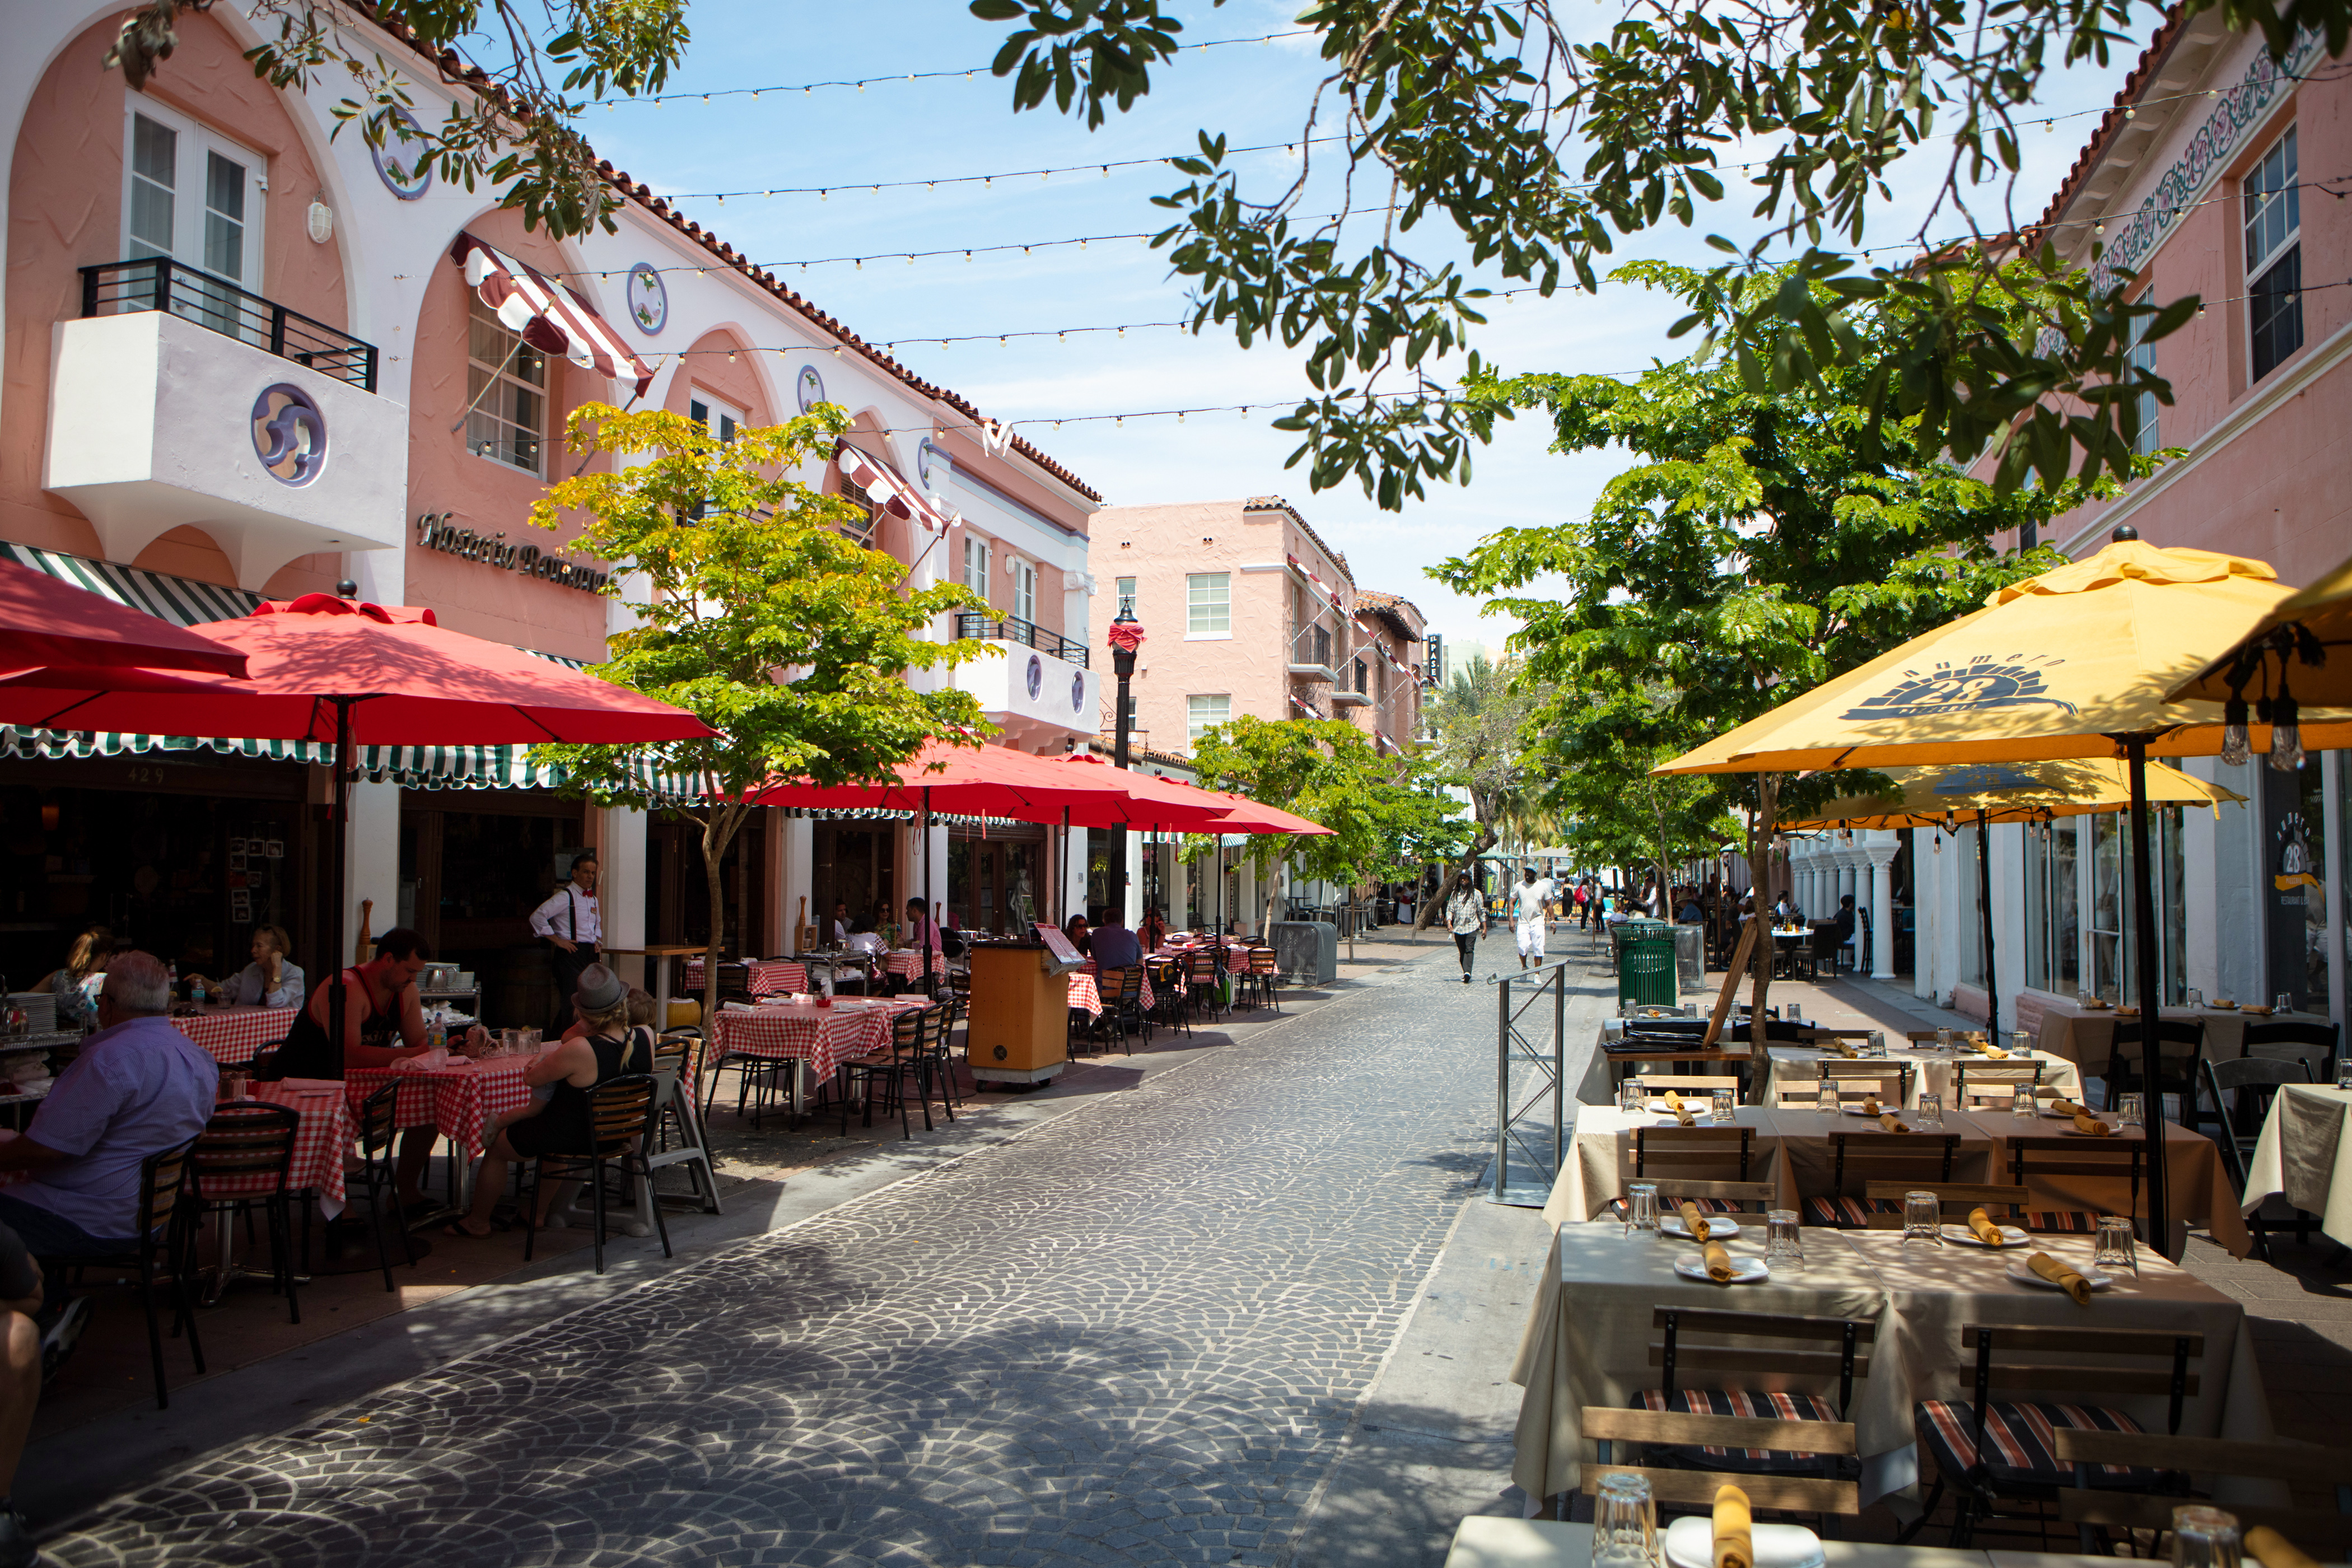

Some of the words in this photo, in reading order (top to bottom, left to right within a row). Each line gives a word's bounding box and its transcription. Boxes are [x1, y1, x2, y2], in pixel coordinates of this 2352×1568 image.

[417, 512, 517, 570] Hosteria
[519, 545, 608, 596] Romana
[1903, 654, 2065, 678] numero
[1911, 678, 1995, 703] 28
[1899, 704, 1978, 715] PIZZERIA
[128, 767, 164, 783] 429
[1964, 774, 2000, 785] 28
[2276, 812, 2311, 841] numero
[2286, 845, 2300, 873] 28
[2281, 896, 2300, 905] RESTAURANT
